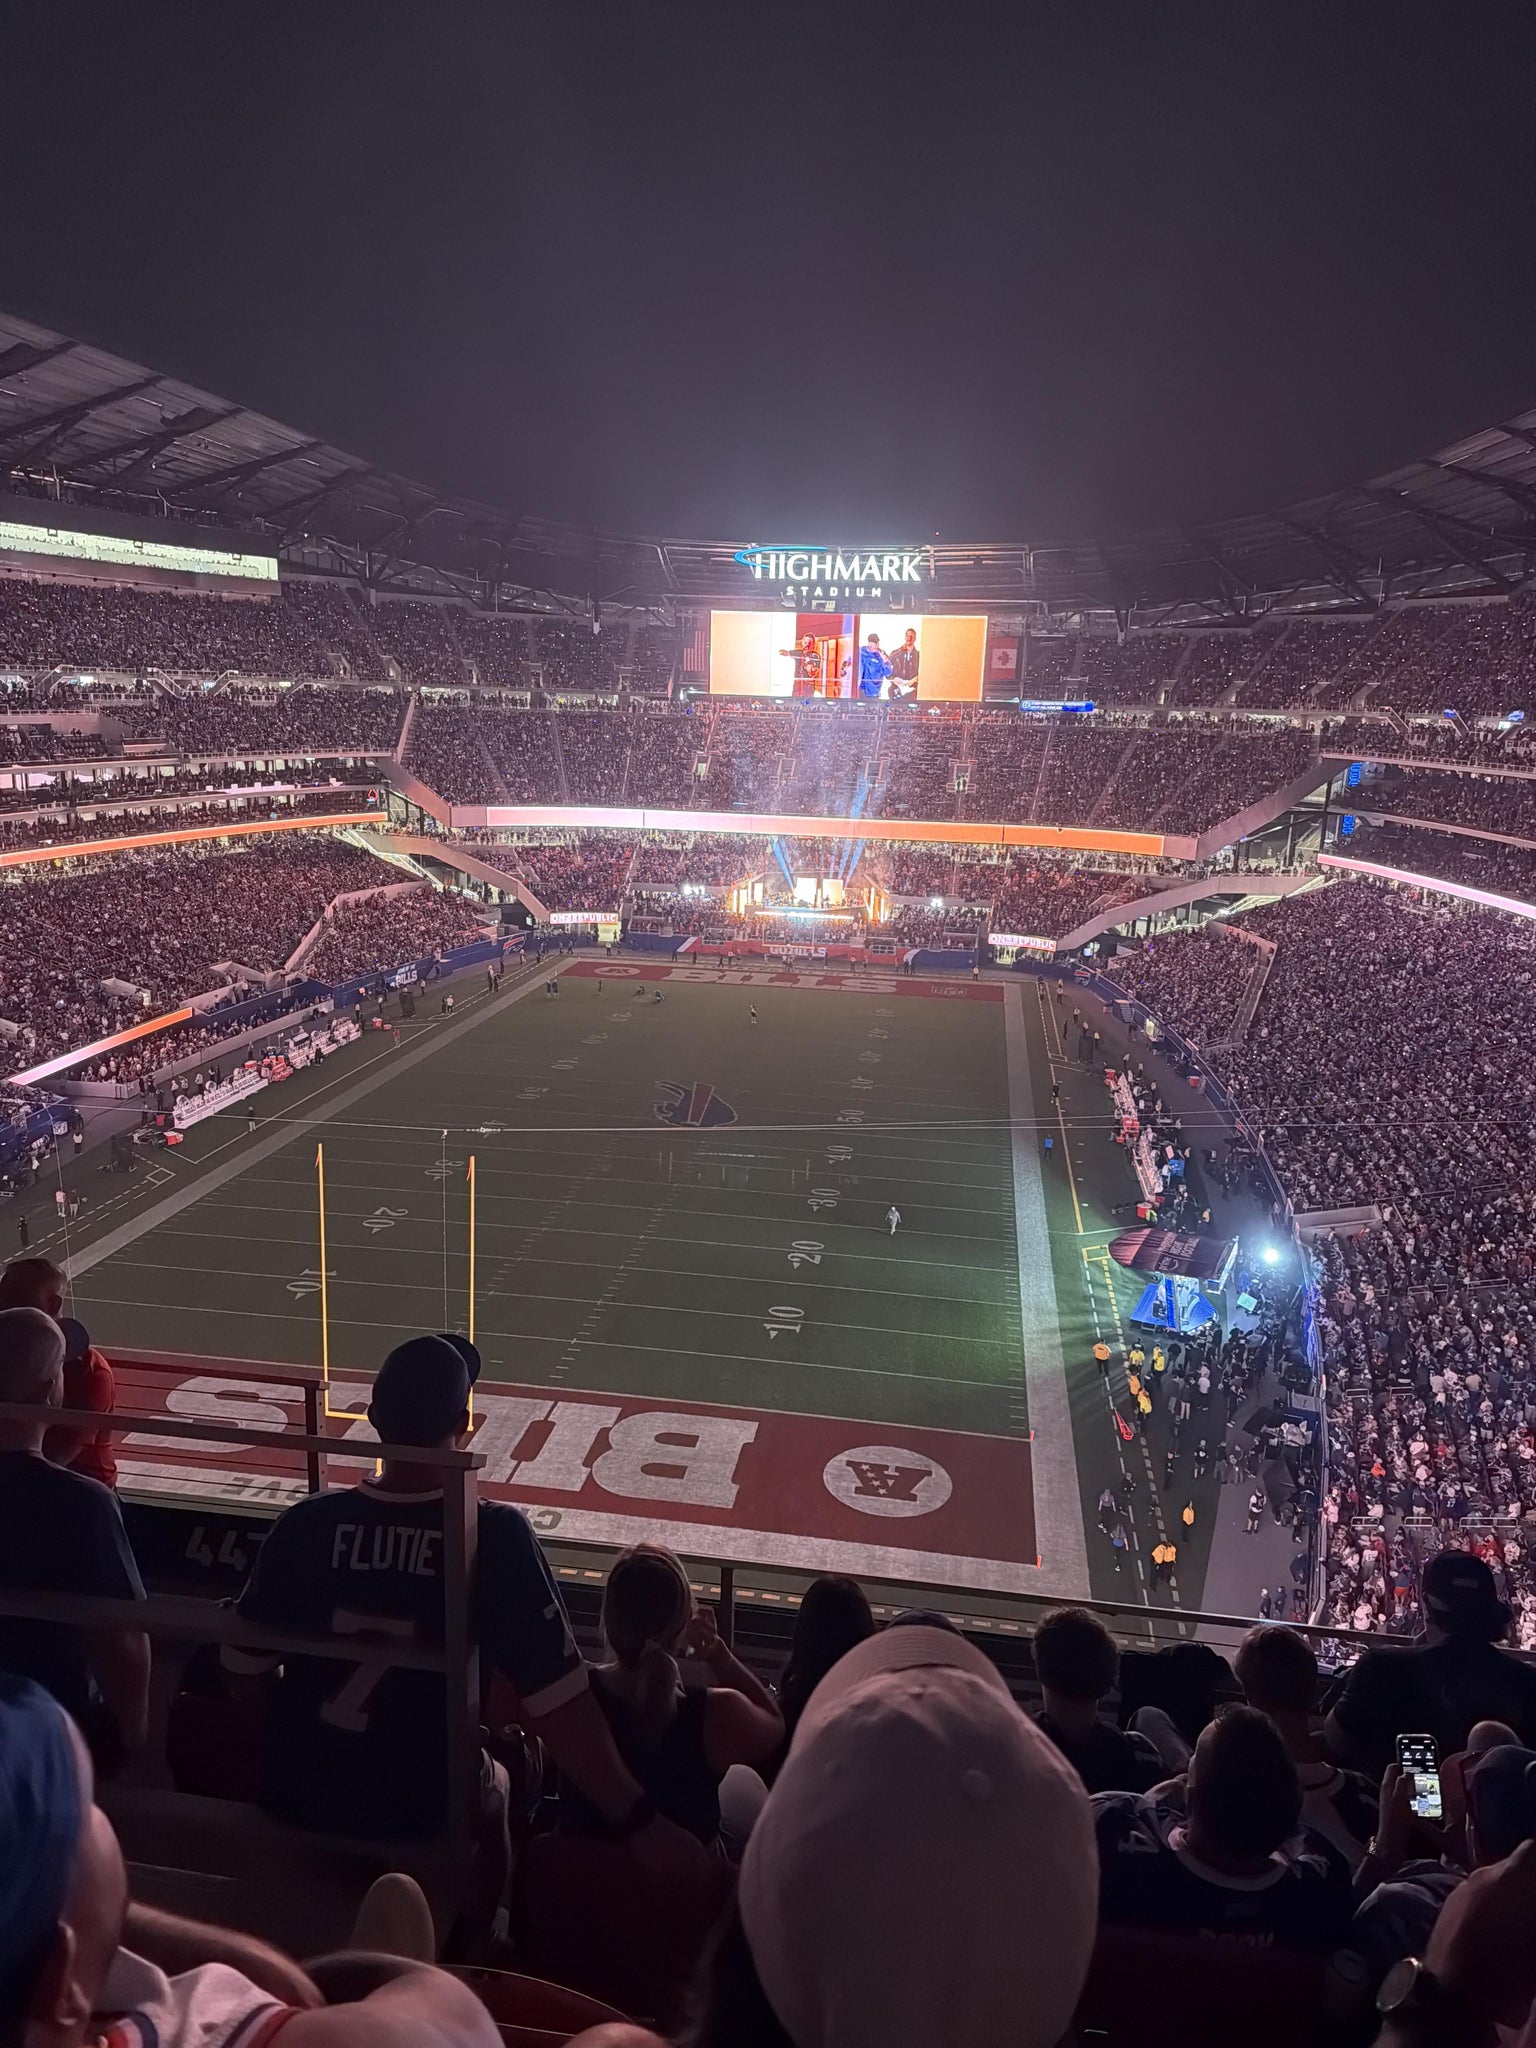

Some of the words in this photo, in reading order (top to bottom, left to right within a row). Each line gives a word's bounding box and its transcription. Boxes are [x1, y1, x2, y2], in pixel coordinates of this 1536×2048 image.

[754, 553, 922, 582] HIGHMARK
[786, 585, 882, 598] STADIUM
[662, 969, 898, 993] BILLS
[808, 1188, 840, 1208] 30
[787, 1240, 825, 1265] 20
[763, 1306, 805, 1334] 10
[331, 1522, 443, 1577] FLUTIE
